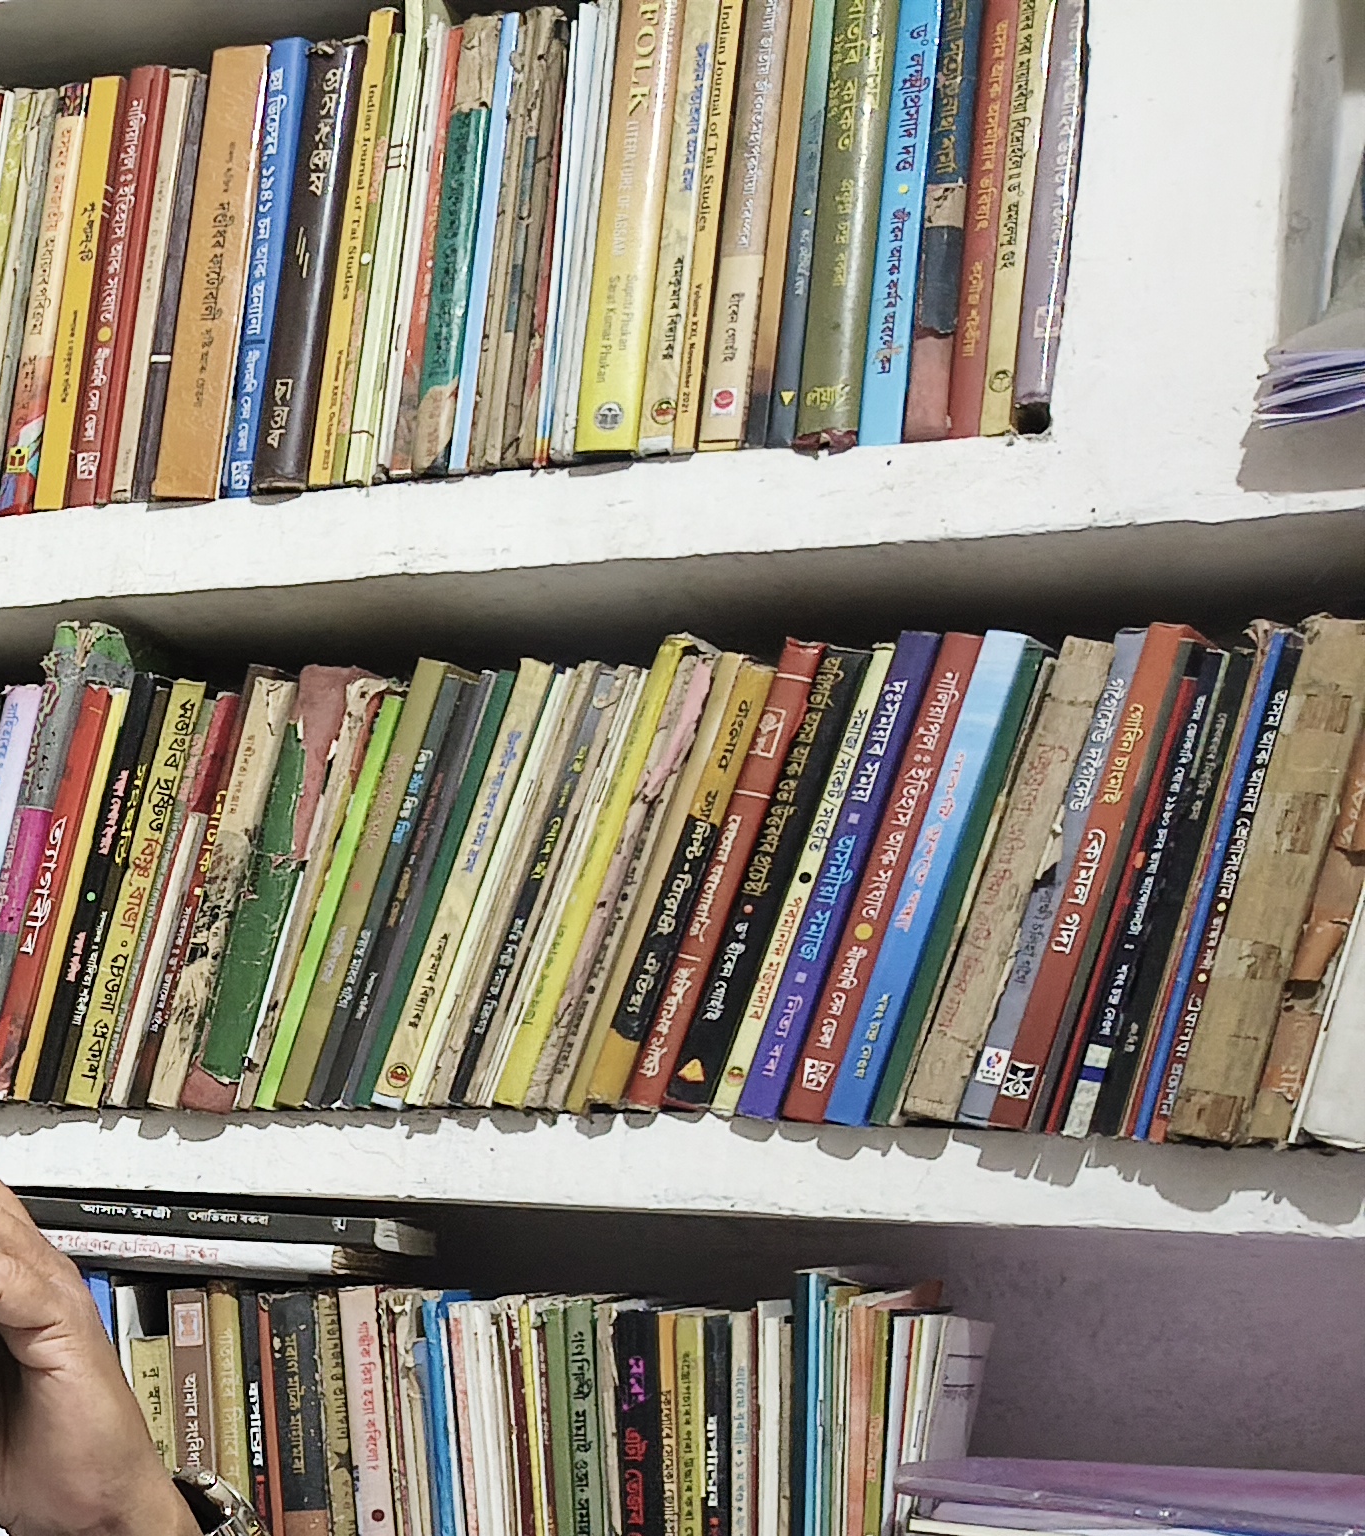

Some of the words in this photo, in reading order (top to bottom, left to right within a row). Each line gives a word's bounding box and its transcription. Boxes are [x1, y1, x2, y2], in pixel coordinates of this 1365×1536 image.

[714, 5, 733, 54] Indian
[625, 2, 658, 117] FOLK
[360, 83, 378, 132] Indian
[707, 59, 726, 117] Journal
[618, 120, 638, 191] LITERATURE
[702, 142, 717, 169] Tai
[705, 121, 720, 138] of
[256, 166, 279, 213] ১৯৪১
[353, 136, 371, 191] Journal
[107, 185, 134, 237] ইতিহাস
[347, 215, 361, 241] Tai
[351, 196, 364, 212] of
[615, 194, 630, 211] OF
[695, 174, 714, 231] Studies
[611, 213, 629, 256] ASSAM
[341, 244, 358, 300] Studies
[890, 765, 928, 828] ইতিহাস
[815, 832, 860, 908] অসমীয়া
[1065, 826, 1108, 906] কোমল
[860, 867, 894, 920] সংঘাত
[797, 907, 838, 964] সমাজ
[1050, 910, 1083, 955] গদ্য
